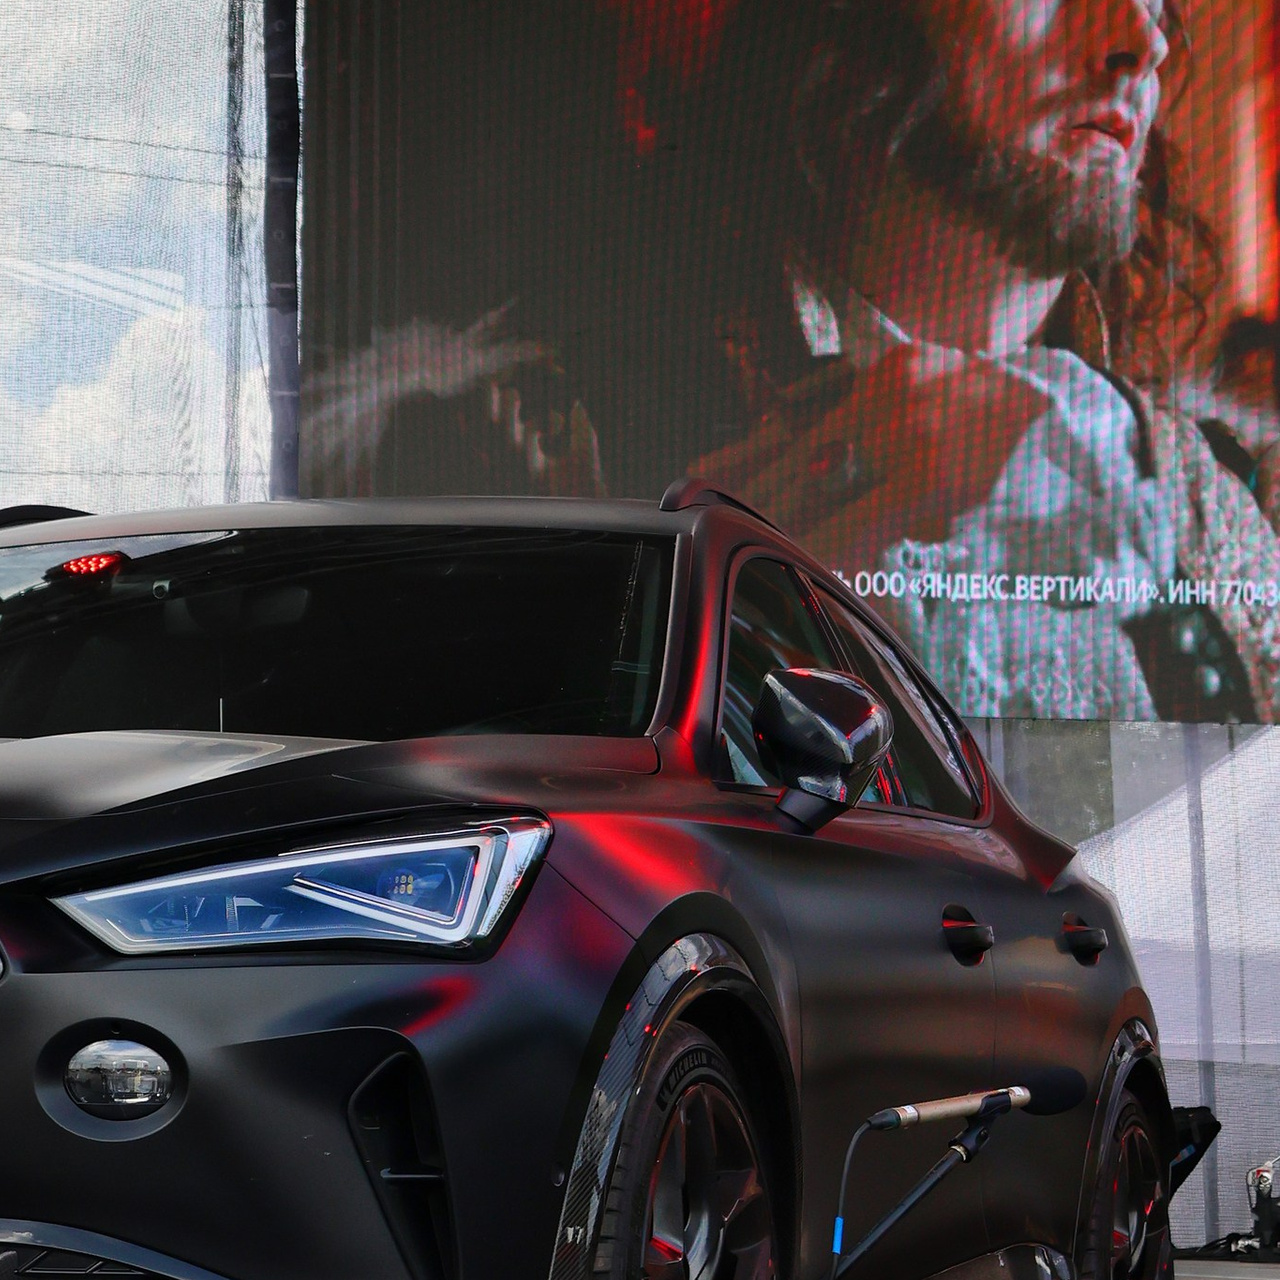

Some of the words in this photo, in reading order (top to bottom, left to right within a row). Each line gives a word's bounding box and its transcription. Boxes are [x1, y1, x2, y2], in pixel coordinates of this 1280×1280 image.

[854, 571, 906, 597] ООО
[1167, 579, 1217, 604] ИНН
[1221, 580, 1280, 607] 77043
